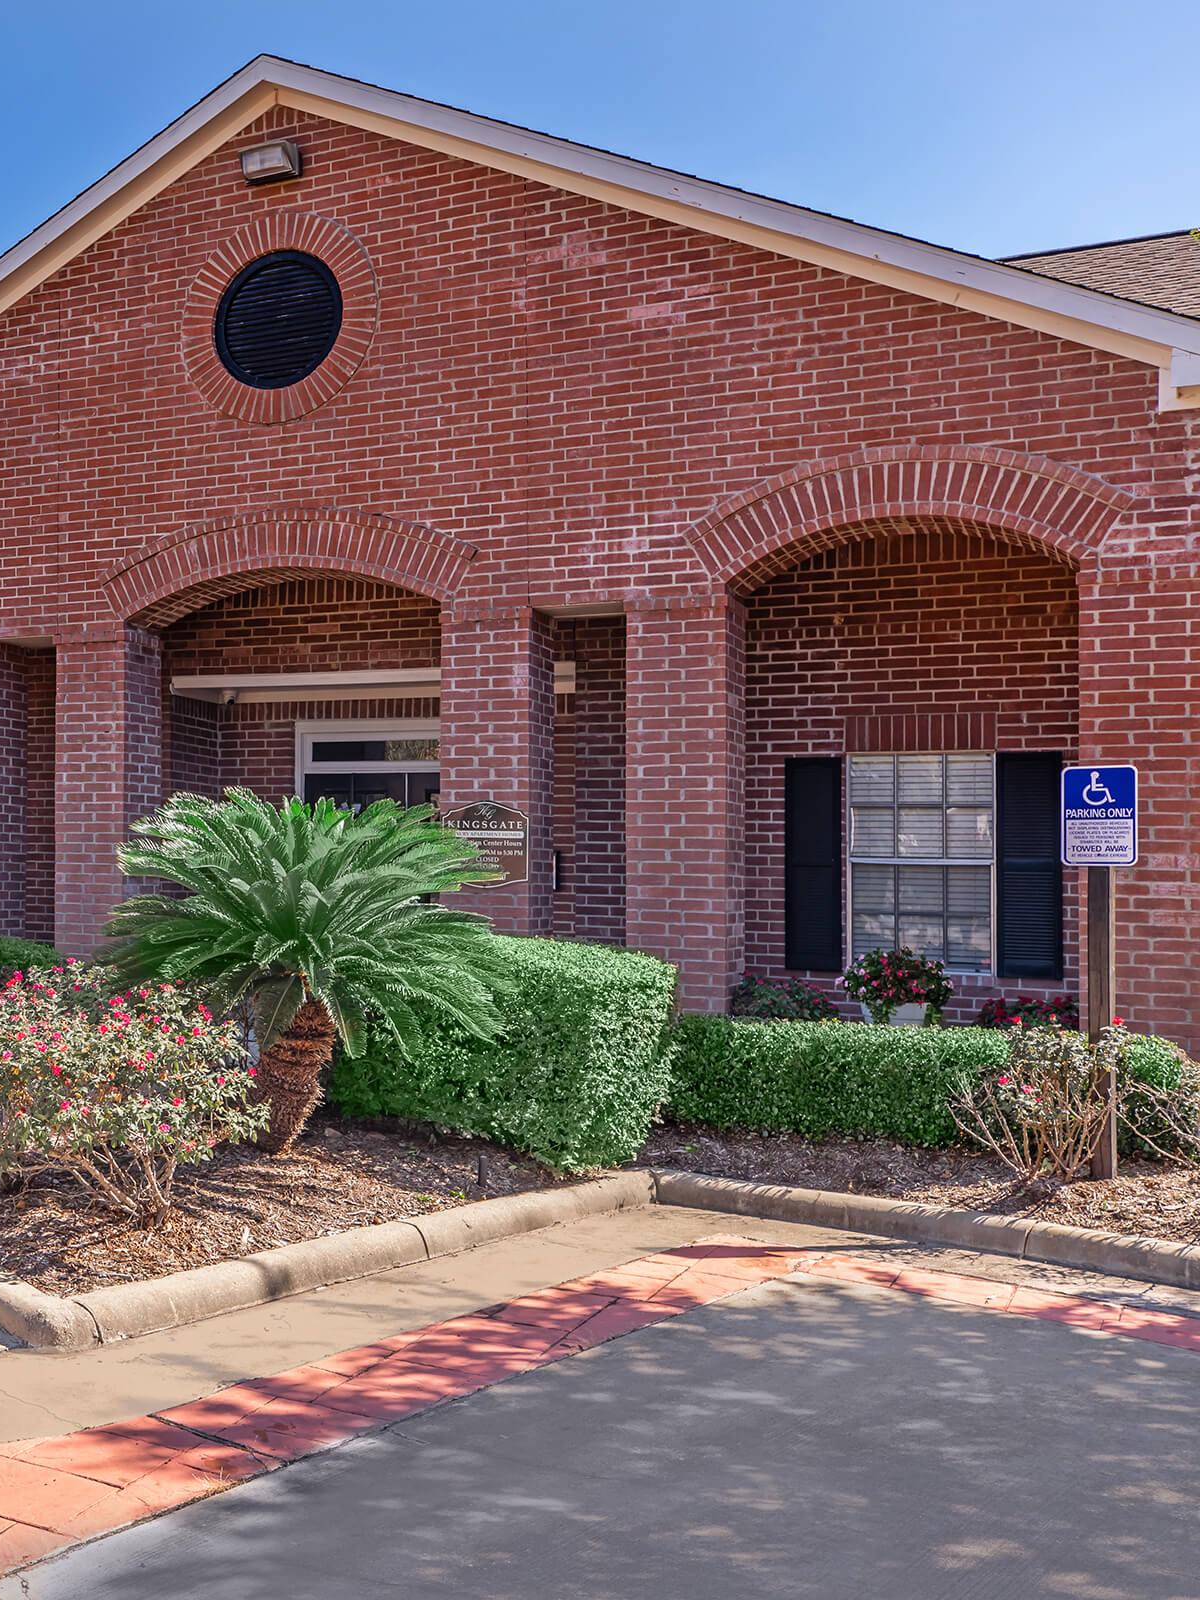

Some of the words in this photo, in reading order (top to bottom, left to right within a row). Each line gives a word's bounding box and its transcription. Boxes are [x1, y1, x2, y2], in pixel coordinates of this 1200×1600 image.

[1066, 808, 1106, 818] PARKING
[1108, 808, 1133, 818] ONLY
[448, 820, 523, 829] KINGSGATE
